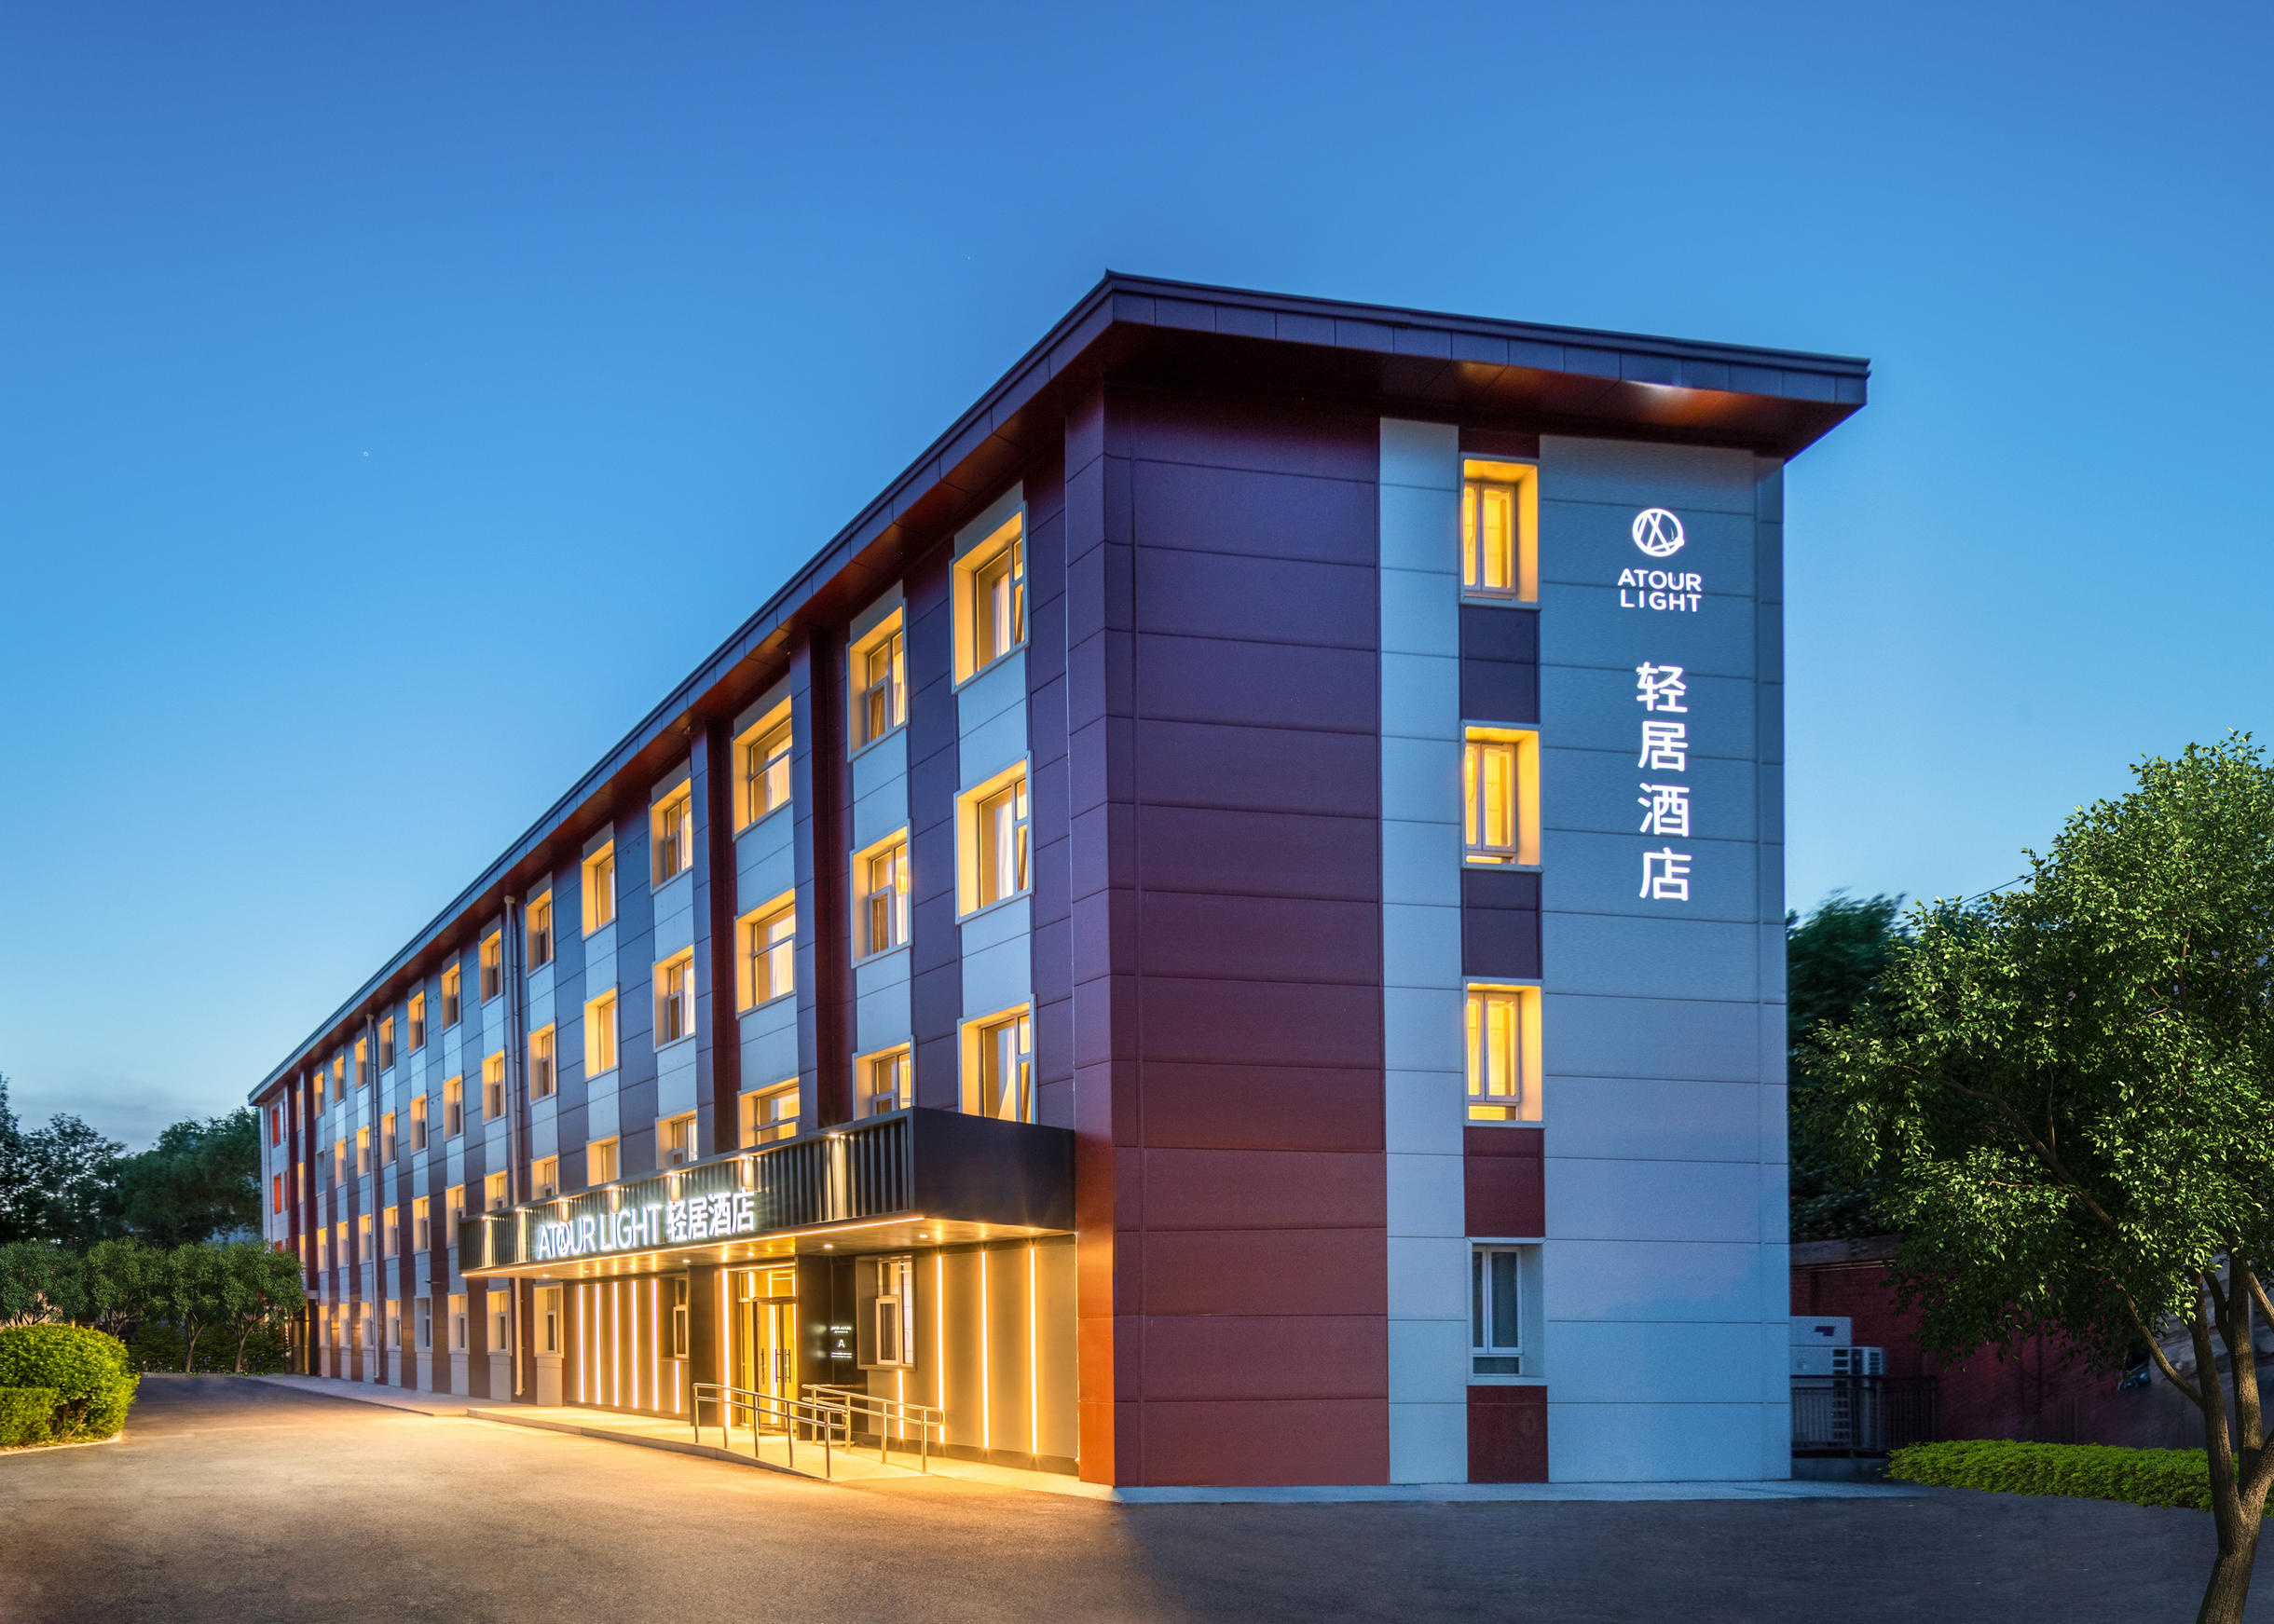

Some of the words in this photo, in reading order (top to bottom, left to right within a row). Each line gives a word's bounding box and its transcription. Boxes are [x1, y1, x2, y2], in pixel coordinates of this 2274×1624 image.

[1618, 567, 1702, 592] ATOUR
[1621, 589, 1702, 612] LIGHT
[1636, 661, 1692, 901] 轻居酒店
[537, 1215, 596, 1260] ATOUR
[598, 1205, 663, 1251] LIGHT
[666, 1187, 755, 1243] 轻居酒店
